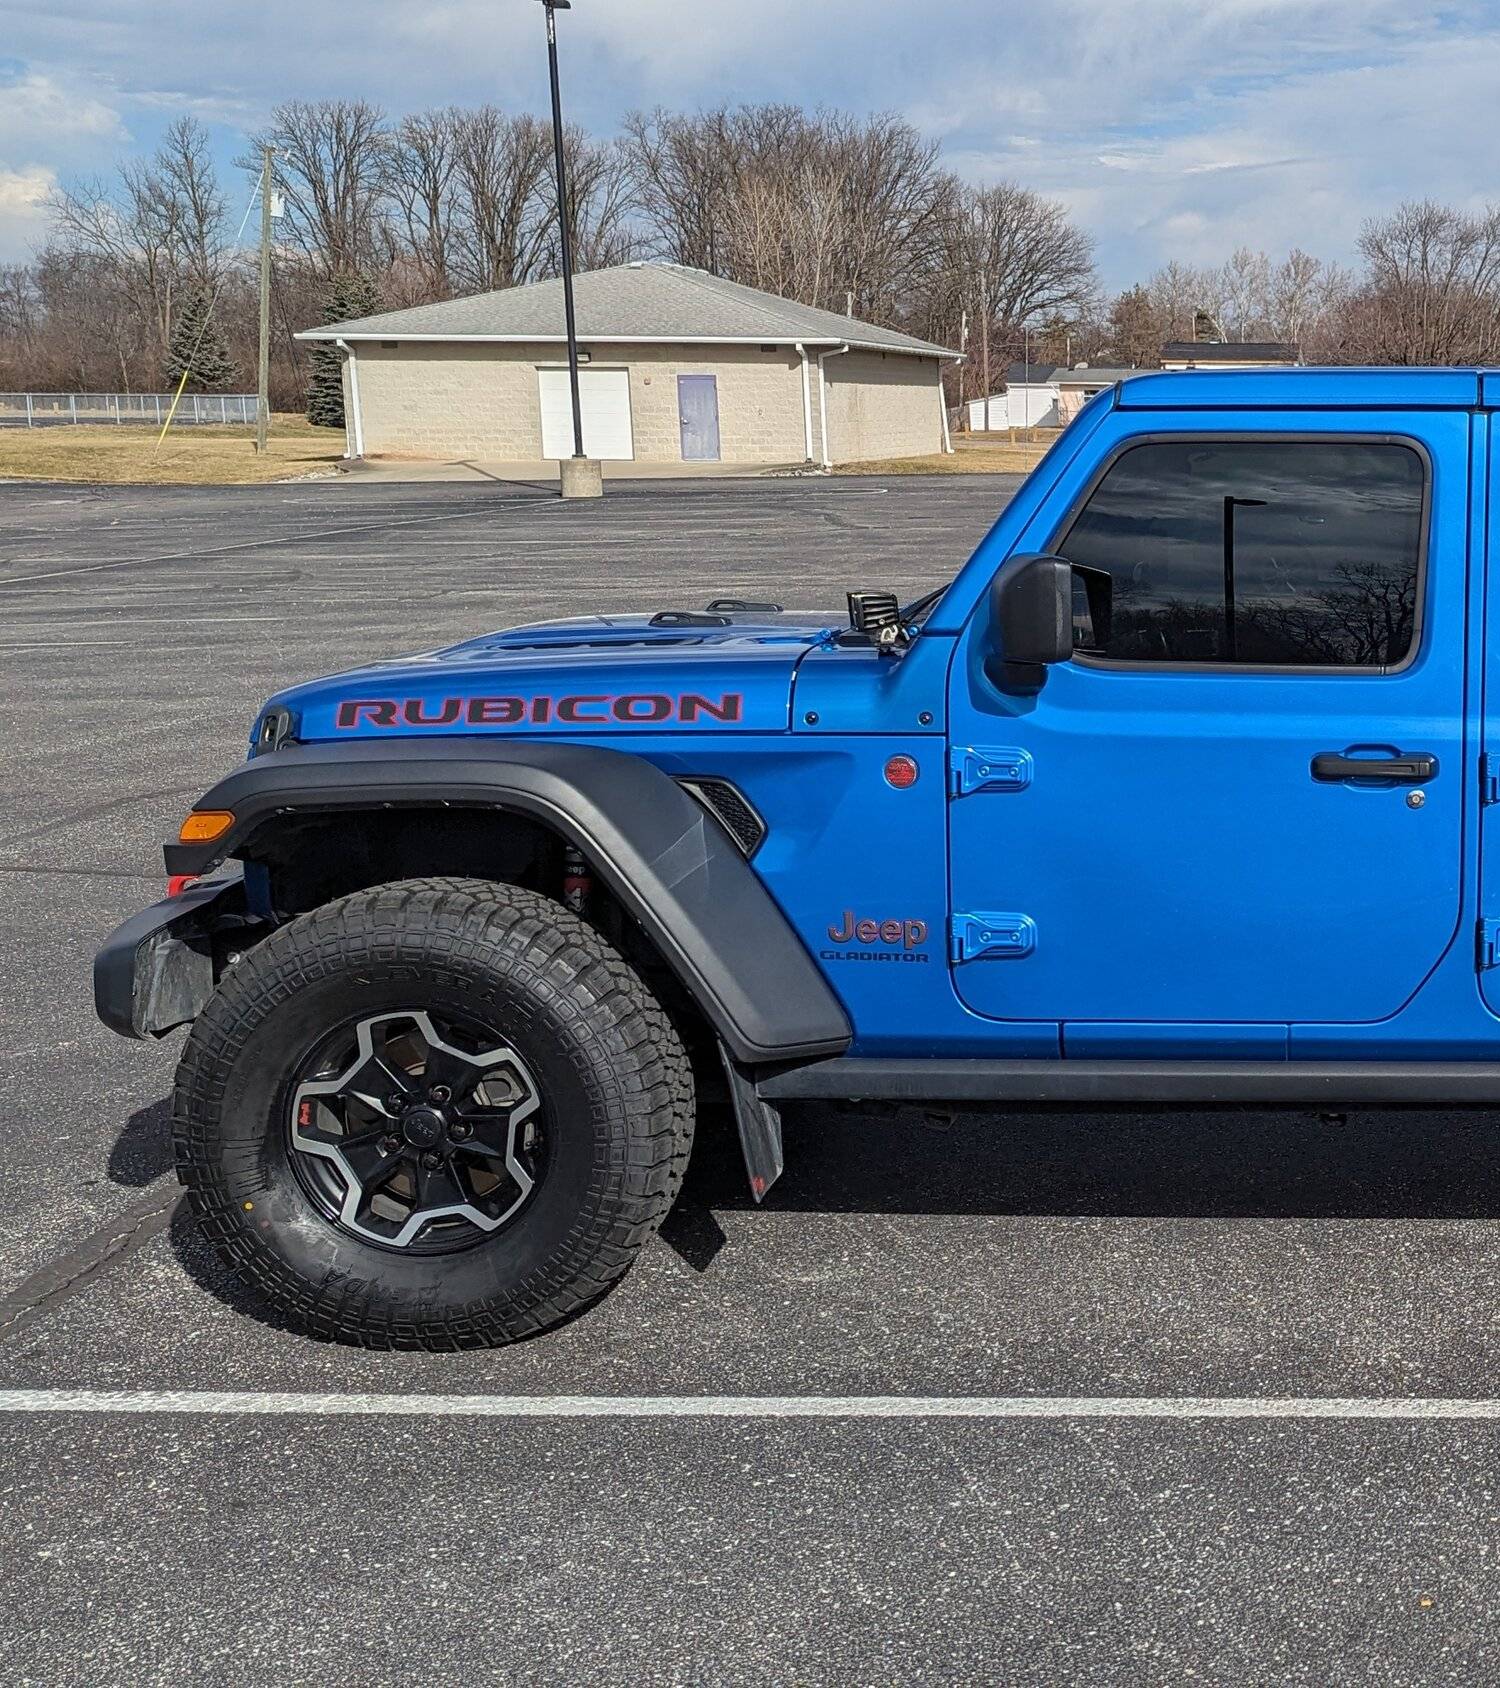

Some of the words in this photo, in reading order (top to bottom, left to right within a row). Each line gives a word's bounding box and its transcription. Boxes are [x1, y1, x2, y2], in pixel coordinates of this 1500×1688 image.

[337, 693, 742, 728] RUBICON
[828, 910, 929, 949] Jeep
[819, 950, 929, 963] GLADIATOR
